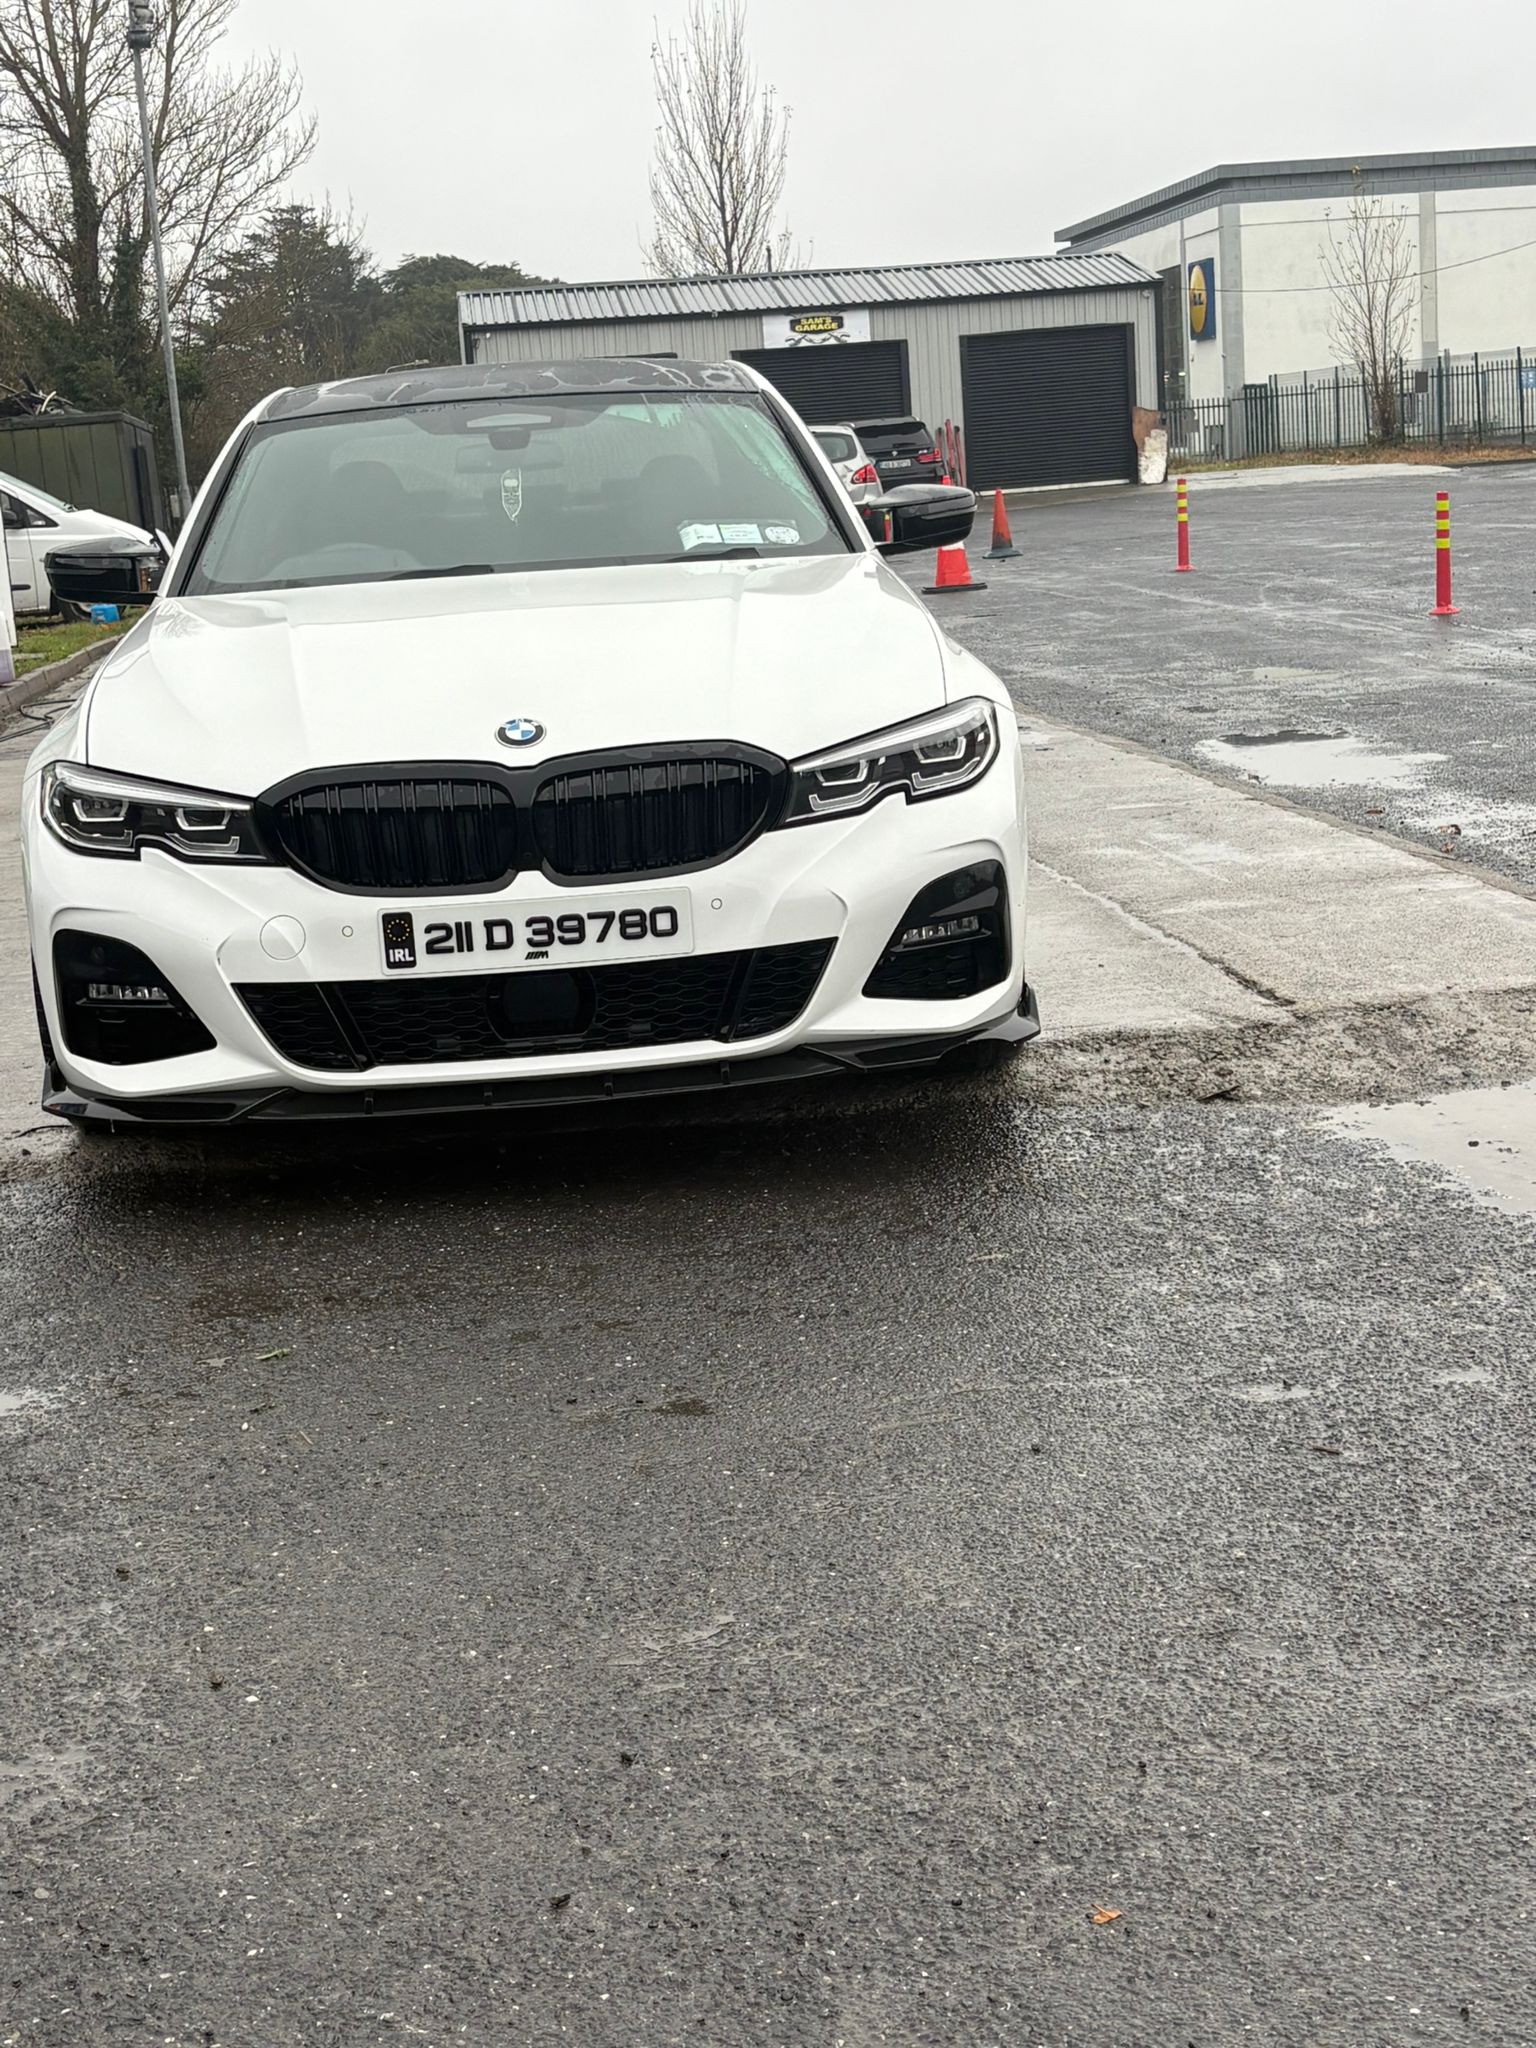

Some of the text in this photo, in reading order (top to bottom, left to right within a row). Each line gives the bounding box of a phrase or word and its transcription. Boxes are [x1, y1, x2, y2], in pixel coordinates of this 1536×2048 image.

[795, 322, 838, 332] GARAGE
[800, 316, 832, 326] SAM'S
[424, 905, 679, 955] 211 D 39780
[389, 948, 414, 964] IRL
